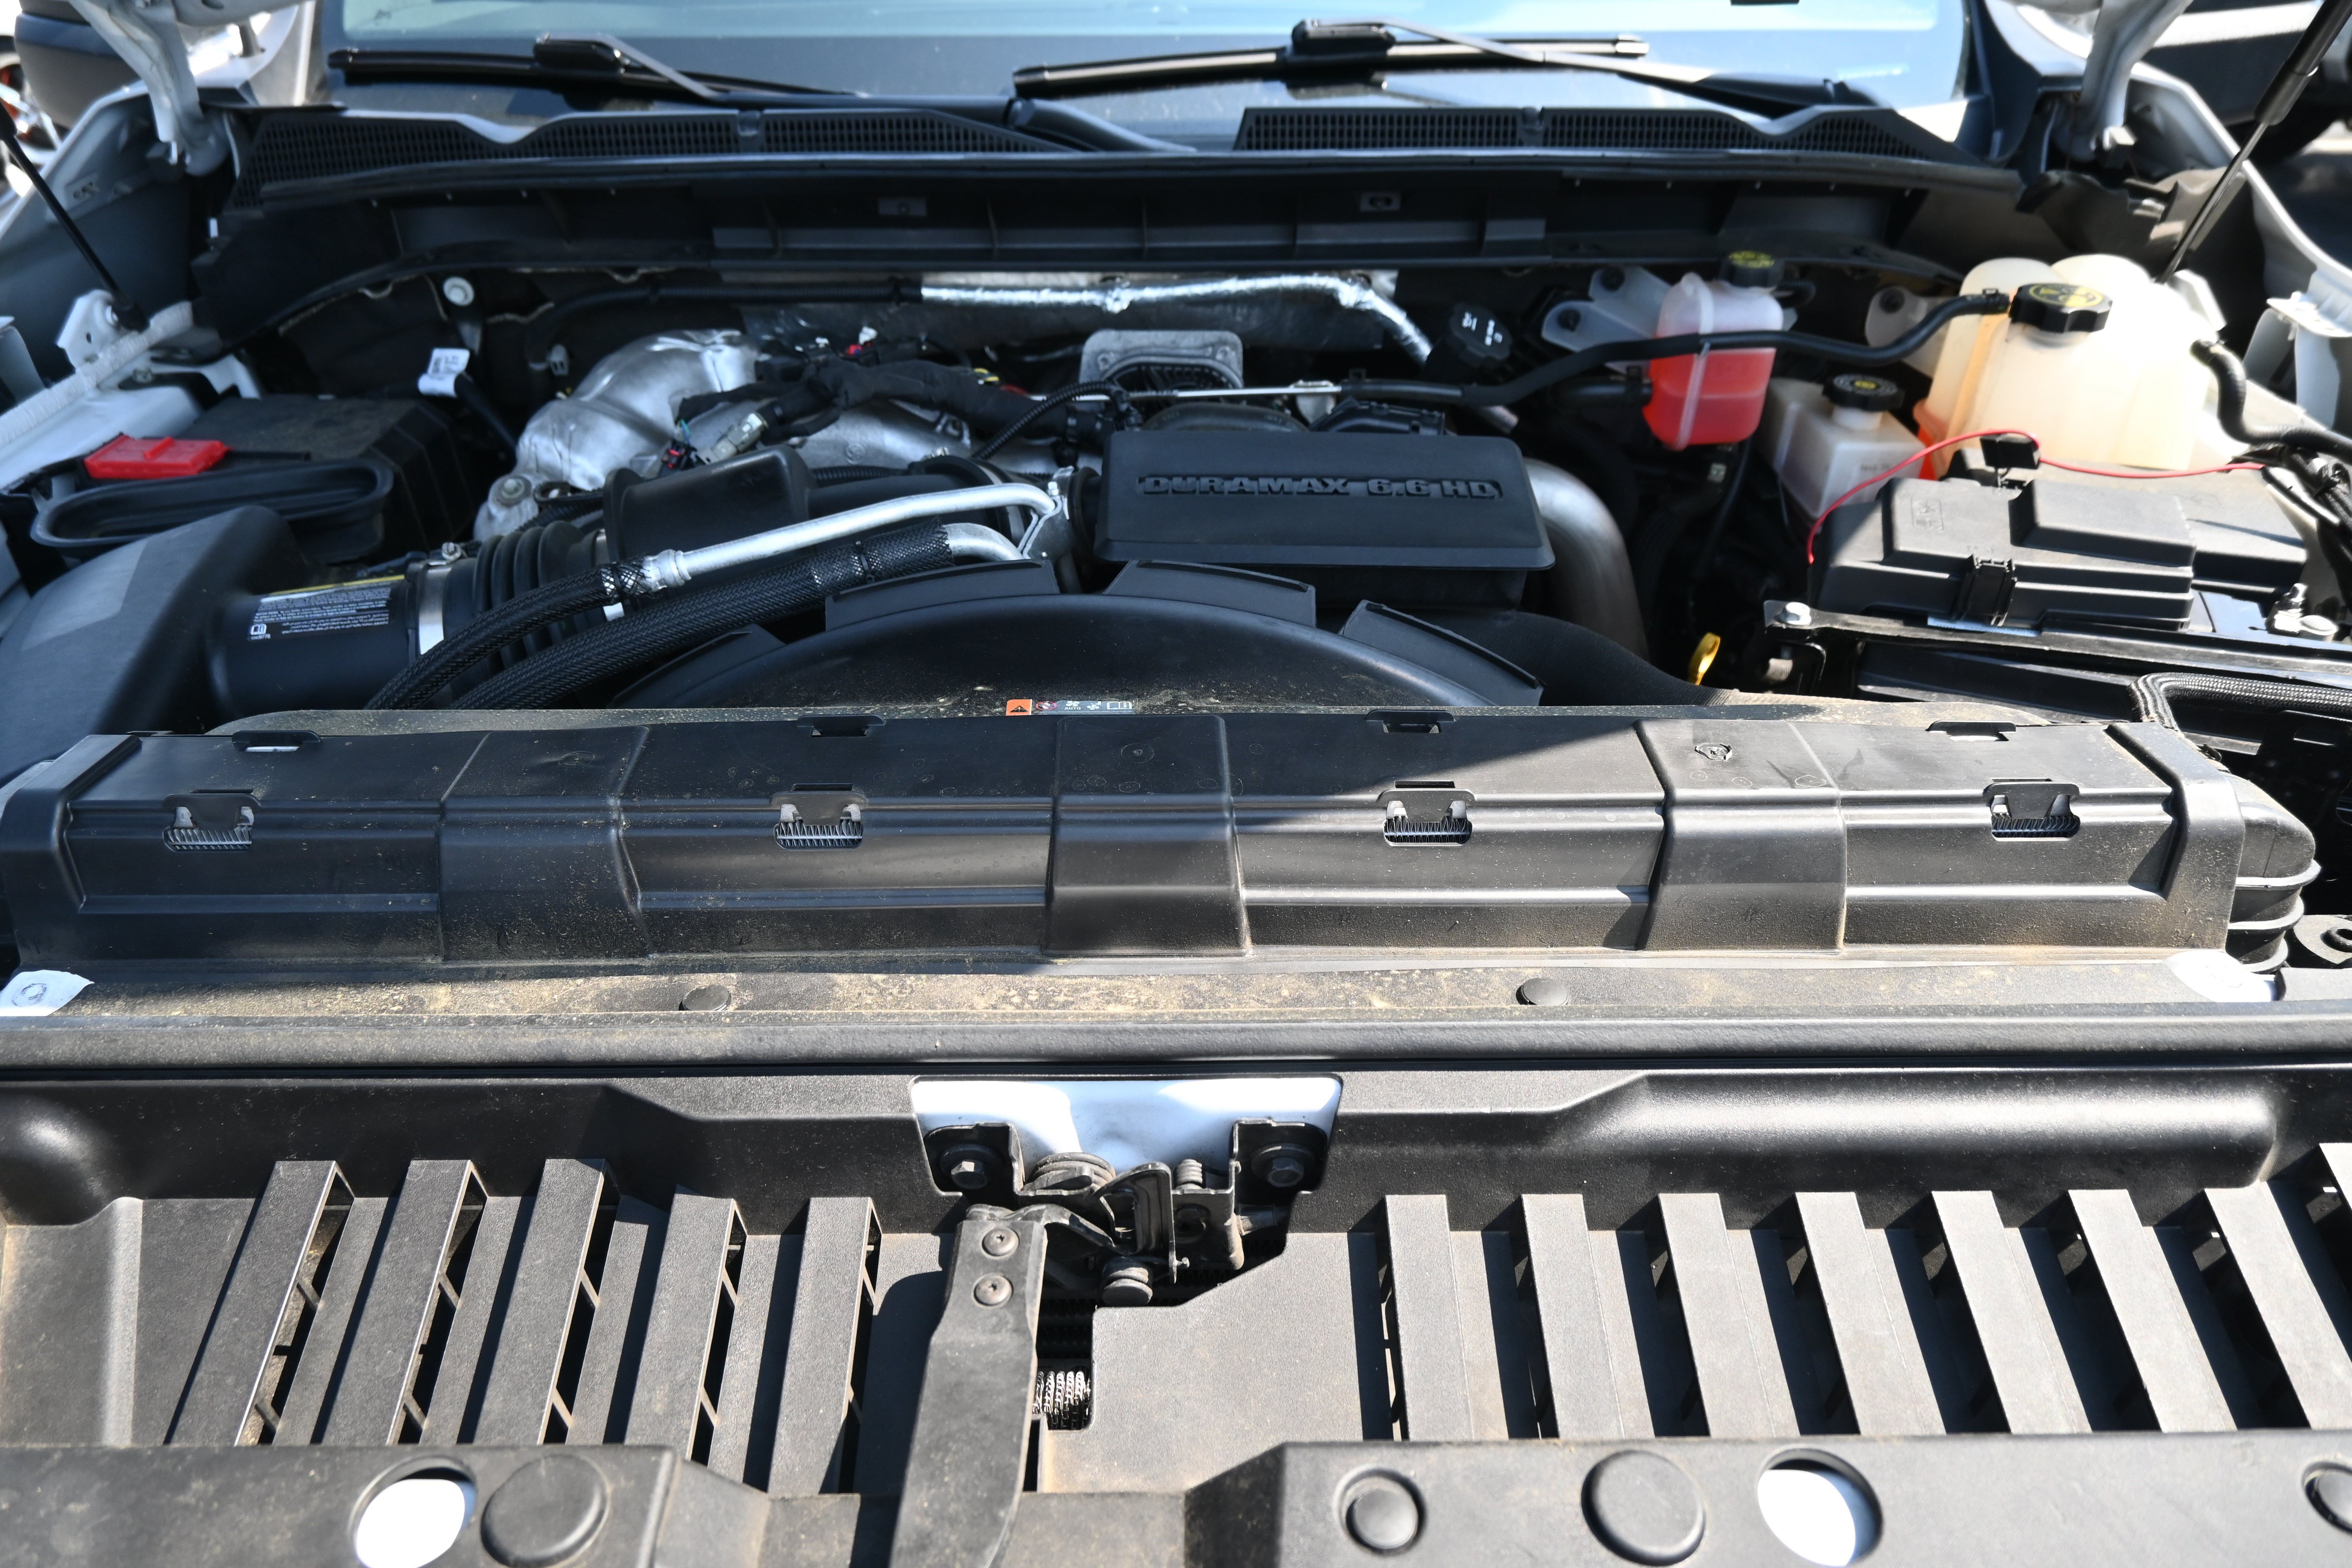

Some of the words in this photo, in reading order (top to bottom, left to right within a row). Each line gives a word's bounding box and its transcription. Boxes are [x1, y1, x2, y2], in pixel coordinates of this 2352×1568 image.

[1143, 476, 1349, 494] DURAMAX
[1367, 478, 1431, 495] 6.6
[1440, 480, 1497, 498] HD
